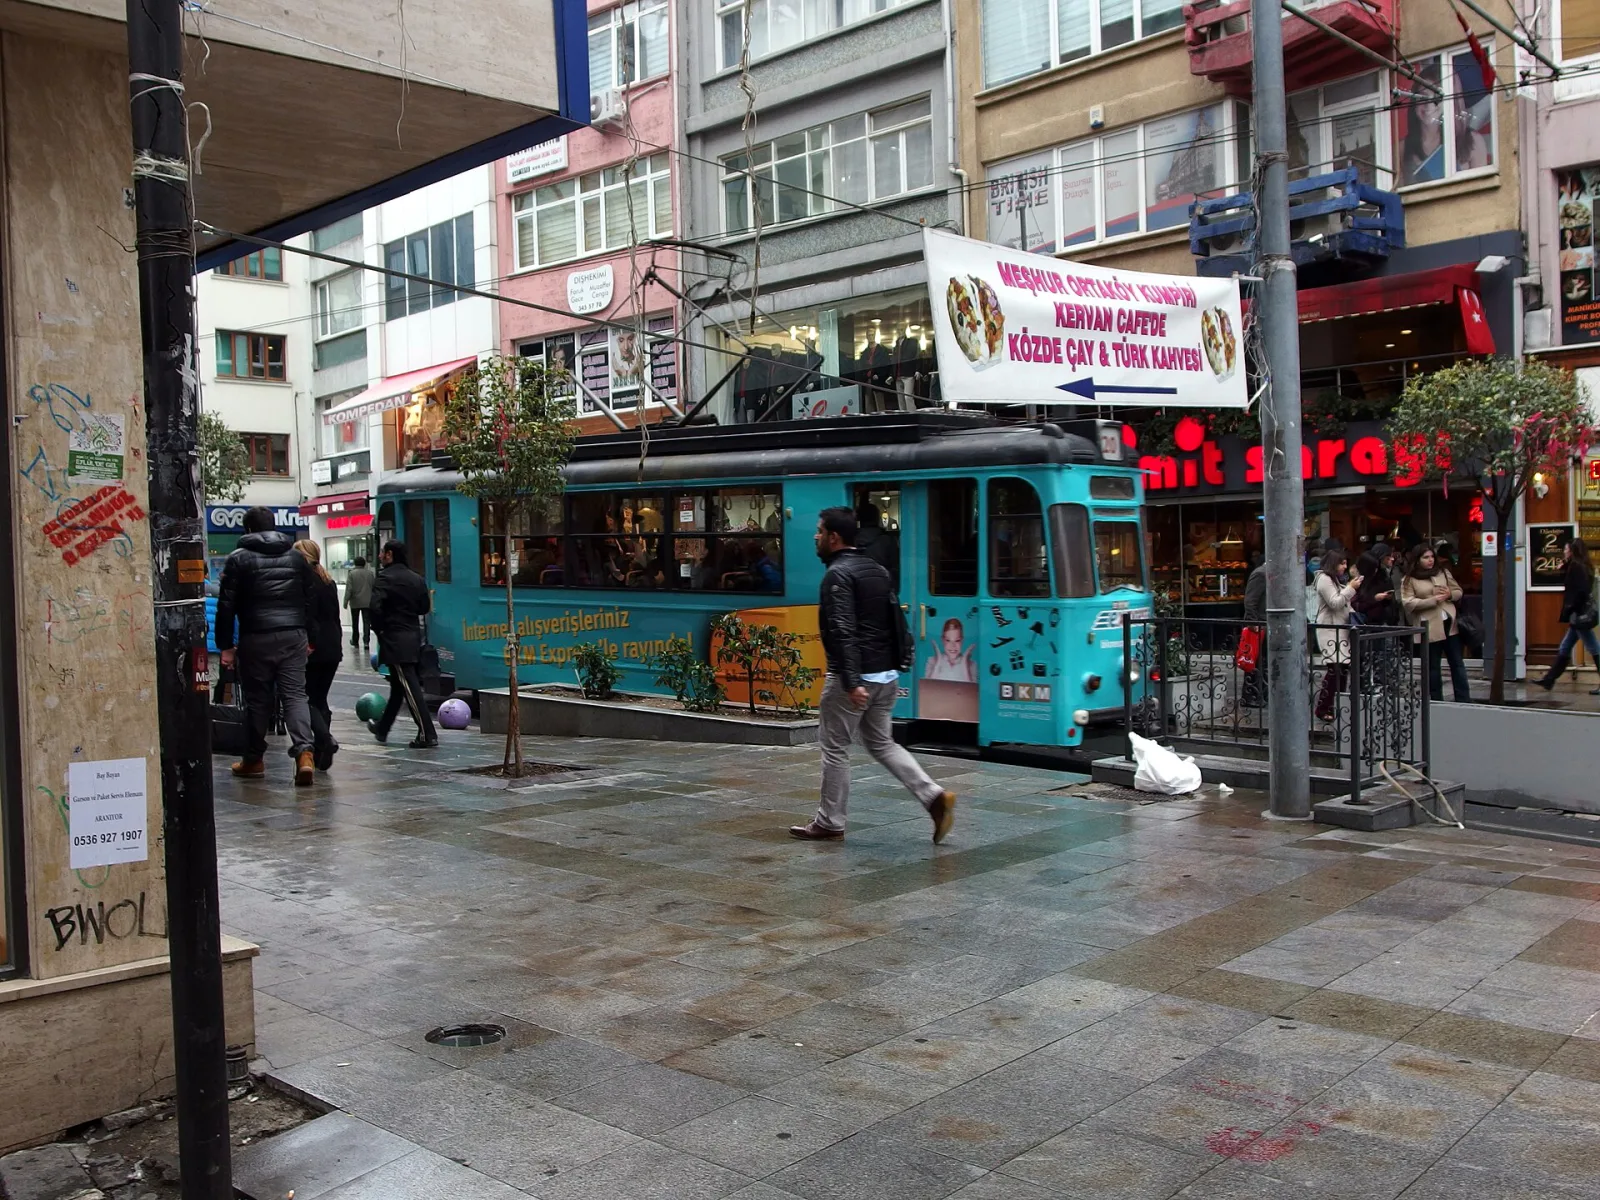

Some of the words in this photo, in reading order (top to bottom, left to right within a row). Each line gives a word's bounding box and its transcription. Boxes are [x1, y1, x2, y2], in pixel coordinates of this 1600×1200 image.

[990, 164, 1050, 199] BRITISH
[991, 188, 1049, 217] TIME
[996, 260, 1068, 297] MEŞHUR
[1066, 274, 1137, 302] ORTAKÖY
[1136, 281, 1198, 308] KUMPİRİ
[1053, 301, 1114, 332] KERVAN
[1116, 308, 1167, 337] CAFE'DE
[1007, 327, 1064, 364] KÖZDE
[1066, 338, 1095, 372] ÇAY
[1099, 340, 1112, 367] &
[1112, 336, 1150, 369] TÜRK
[1152, 342, 1204, 372] KAHVESİ
[328, 394, 407, 425] KOMPEDAN
[1122, 417, 1225, 491] mit
[1545, 533, 1558, 549] 2
[462, 616, 509, 642] İnterne
[517, 606, 631, 640] alışverişleriniz
[540, 638, 619, 669] Expre'le
[1001, 684, 1051, 700] BKM
[73, 795, 91, 803] Garson
[110, 792, 124, 800] Servis
[94, 813, 123, 822] ARANIYOR
[74, 834, 98, 846] 0536
[100, 832, 117, 843] 927
[121, 829, 143, 841] 1907
